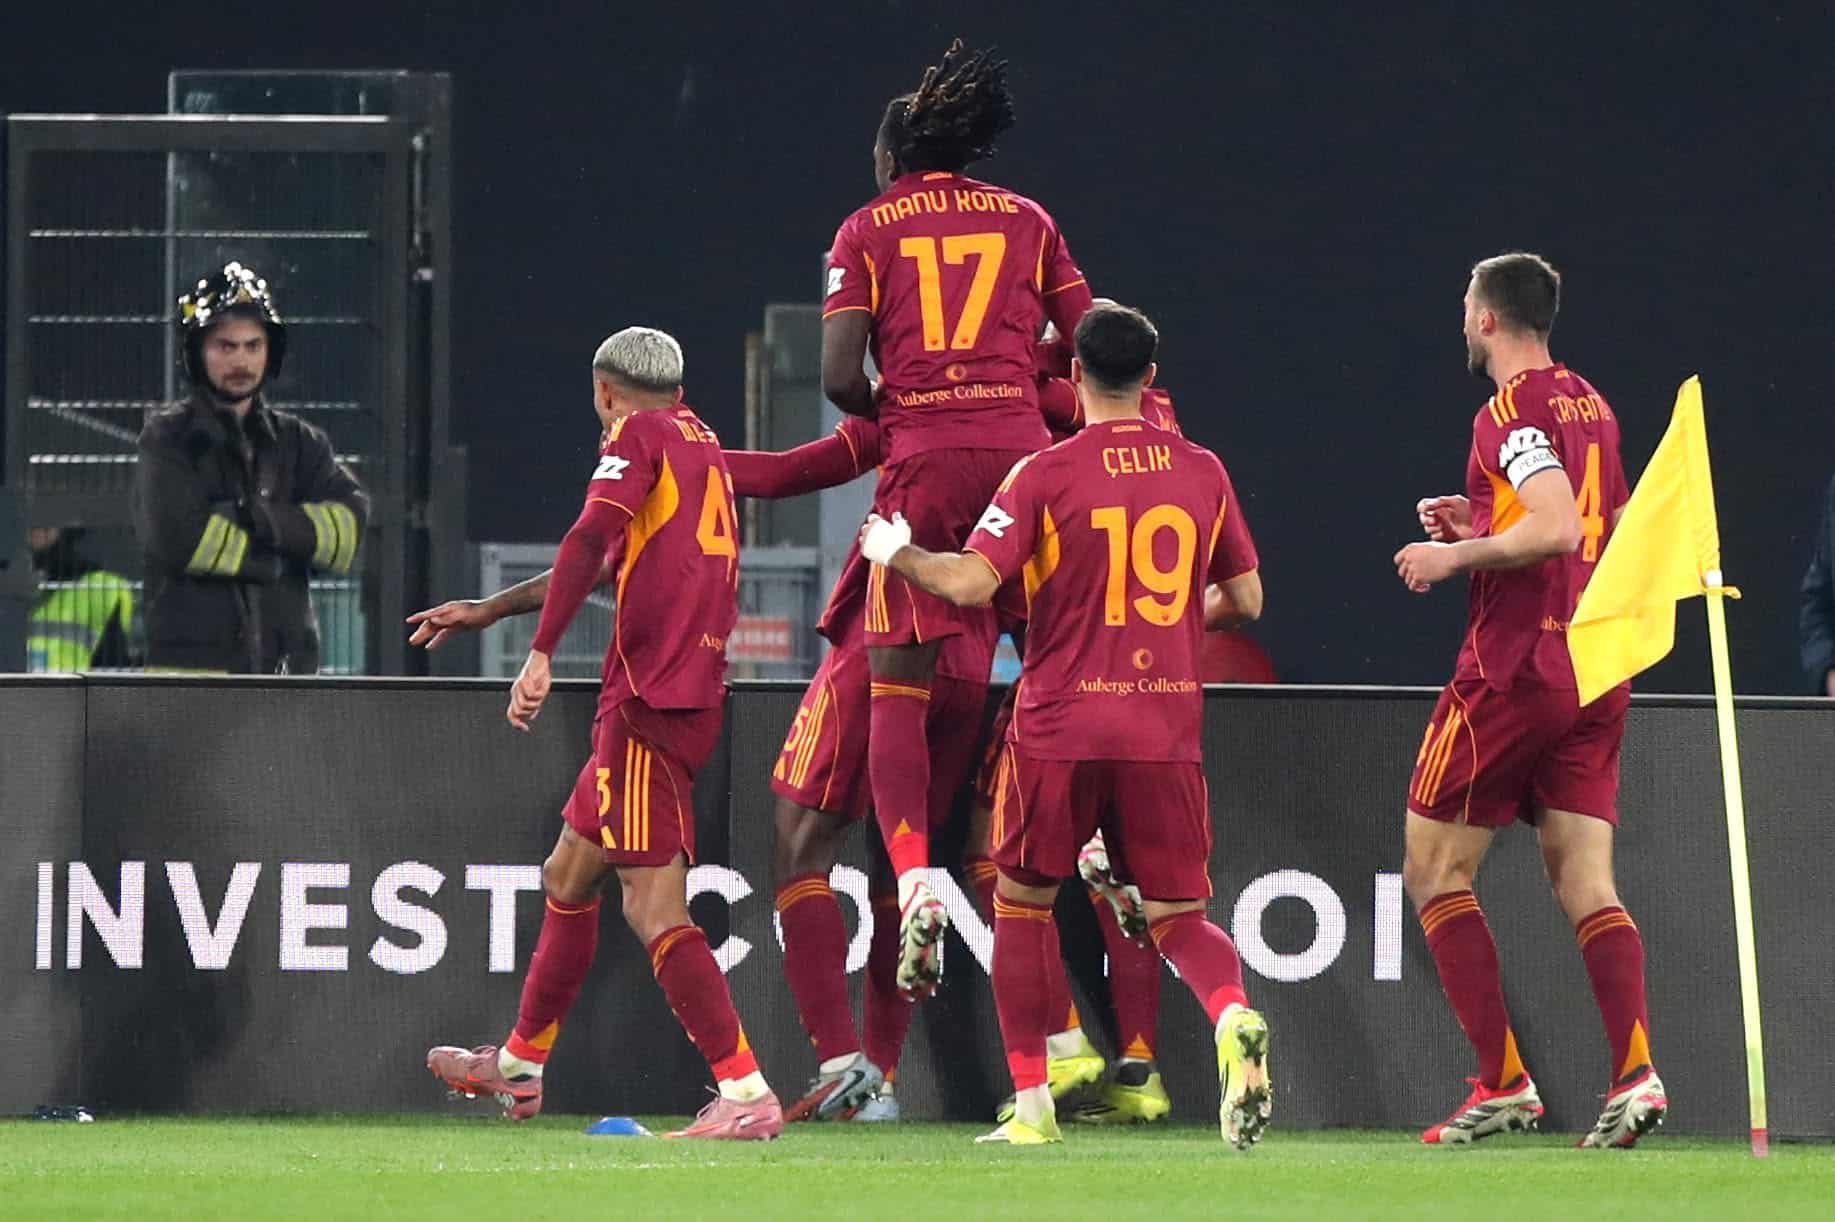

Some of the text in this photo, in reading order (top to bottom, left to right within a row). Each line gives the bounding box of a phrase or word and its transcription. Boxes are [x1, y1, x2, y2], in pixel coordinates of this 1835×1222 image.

[872, 190, 948, 227] MANU
[900, 232, 1007, 352] 17
[896, 384, 1023, 408] Auberge Collection
[1102, 445, 1172, 478] ÇELIK
[1576, 442, 1604, 563] 4
[696, 464, 738, 592] 4
[1090, 503, 1198, 627] 19
[1075, 677, 1135, 696] Auberge
[34, 860, 542, 974] INVEST
